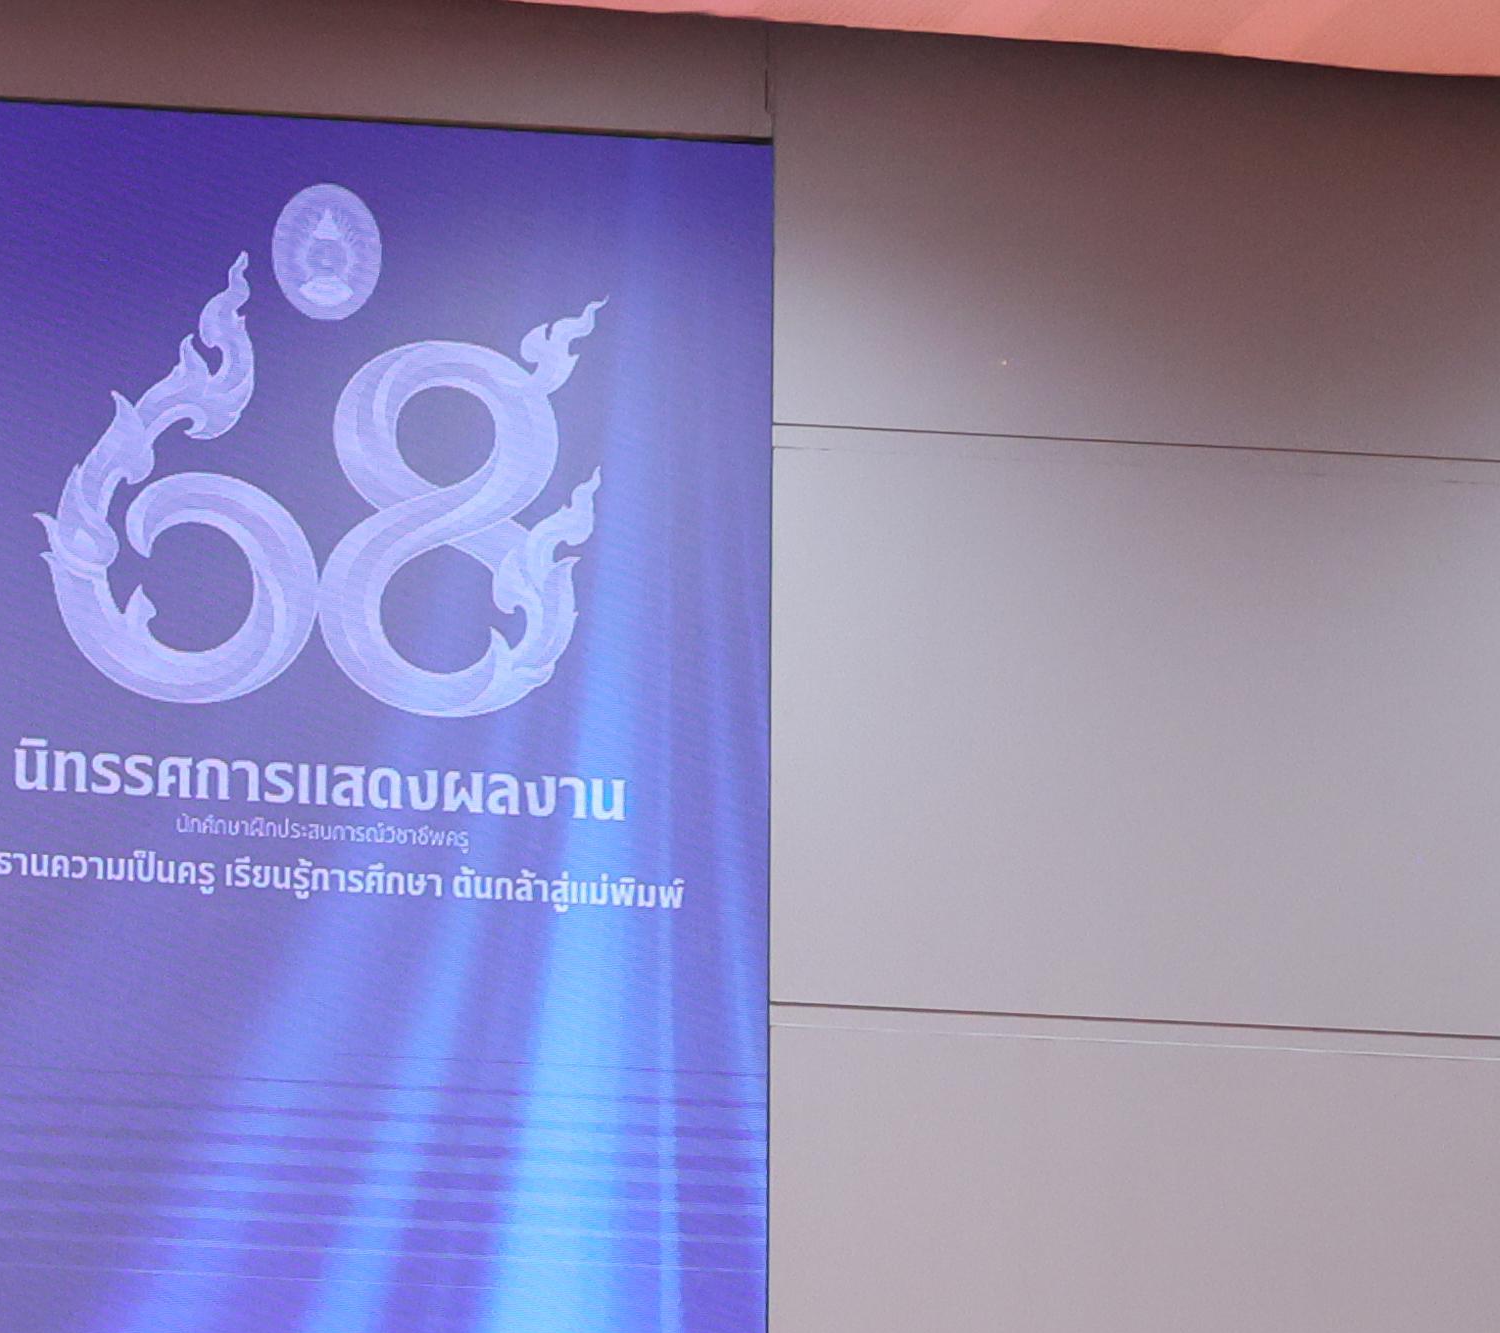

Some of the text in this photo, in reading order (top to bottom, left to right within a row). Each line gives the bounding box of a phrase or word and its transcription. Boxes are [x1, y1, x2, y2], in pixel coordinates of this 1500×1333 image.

[13, 736, 627, 822] นิทรรศการแสดงผลงาน
[224, 856, 443, 899] เรียนรู้การศึกษา
[451, 874, 685, 915] ต้นกล้าสู่แม่พิมพ์
